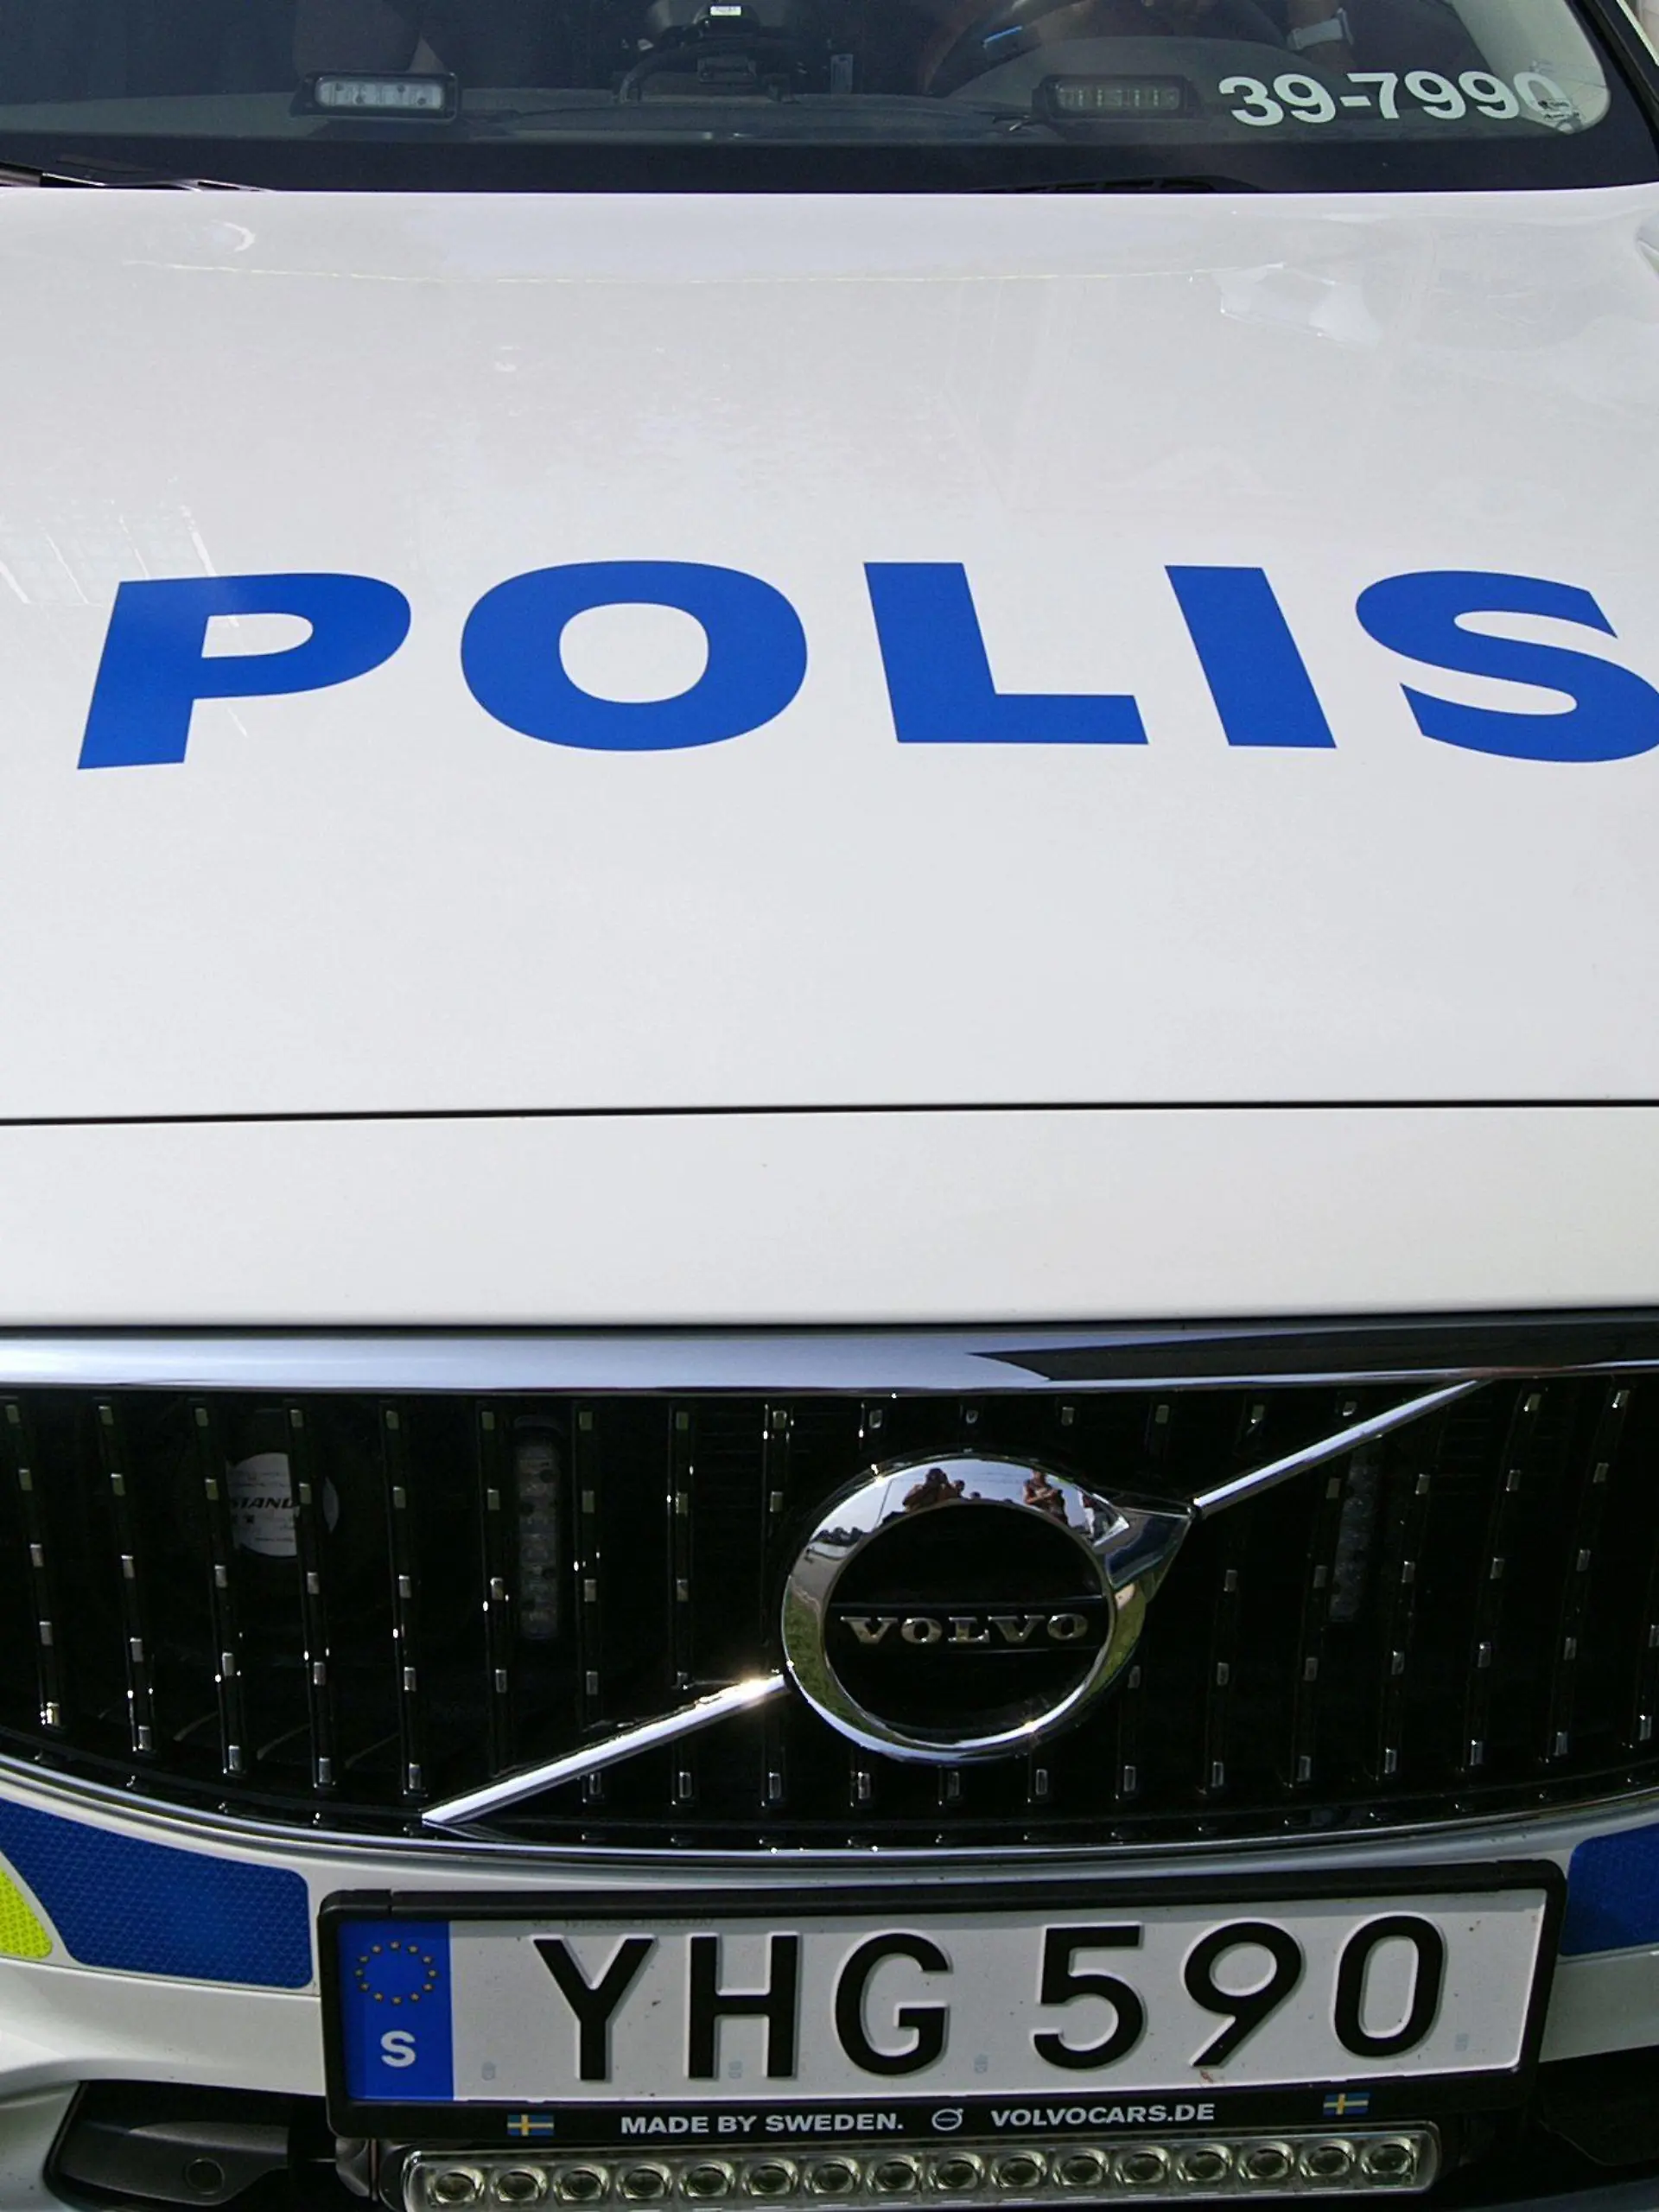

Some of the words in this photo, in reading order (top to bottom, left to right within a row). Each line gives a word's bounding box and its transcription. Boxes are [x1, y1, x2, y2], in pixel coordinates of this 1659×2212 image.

[1218, 71, 1573, 127] 39-7990
[78, 560, 1659, 771] POLIS
[839, 1612, 1089, 1643] VOLVO
[533, 1932, 950, 2082] YHG
[1033, 1914, 1444, 2070] 590
[380, 2031, 416, 2068] S
[621, 2117, 709, 2134] MADE
[718, 2115, 757, 2133] BY
[766, 2113, 904, 2132] SWEDEN.
[991, 2103, 1215, 2126] VOLVOCARS.DE
